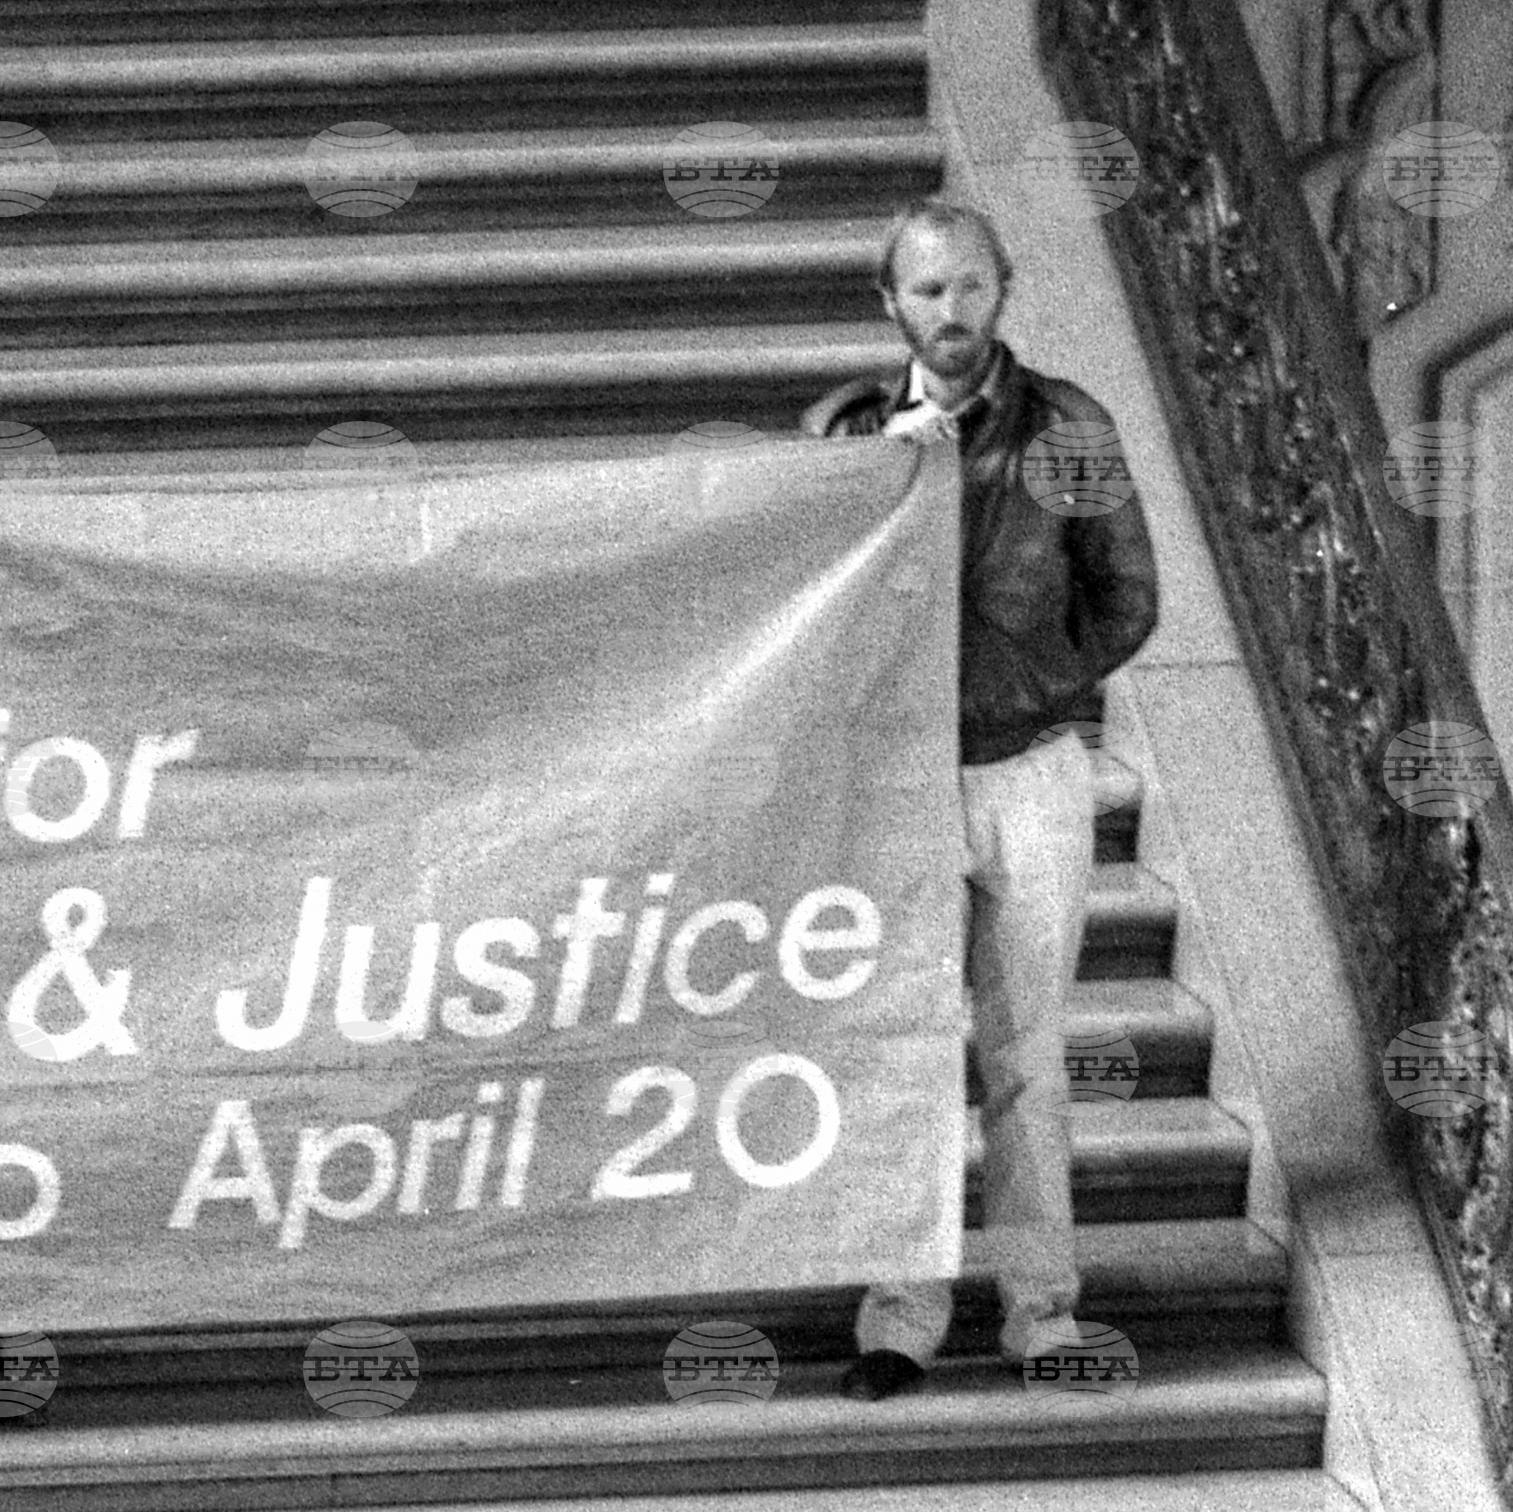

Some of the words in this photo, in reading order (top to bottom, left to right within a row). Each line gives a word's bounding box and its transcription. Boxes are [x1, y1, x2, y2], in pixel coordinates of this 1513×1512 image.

[7, 887, 138, 1062] &
[216, 873, 881, 1052] Justice
[168, 1077, 543, 1250] April
[593, 1053, 841, 1200] 20
